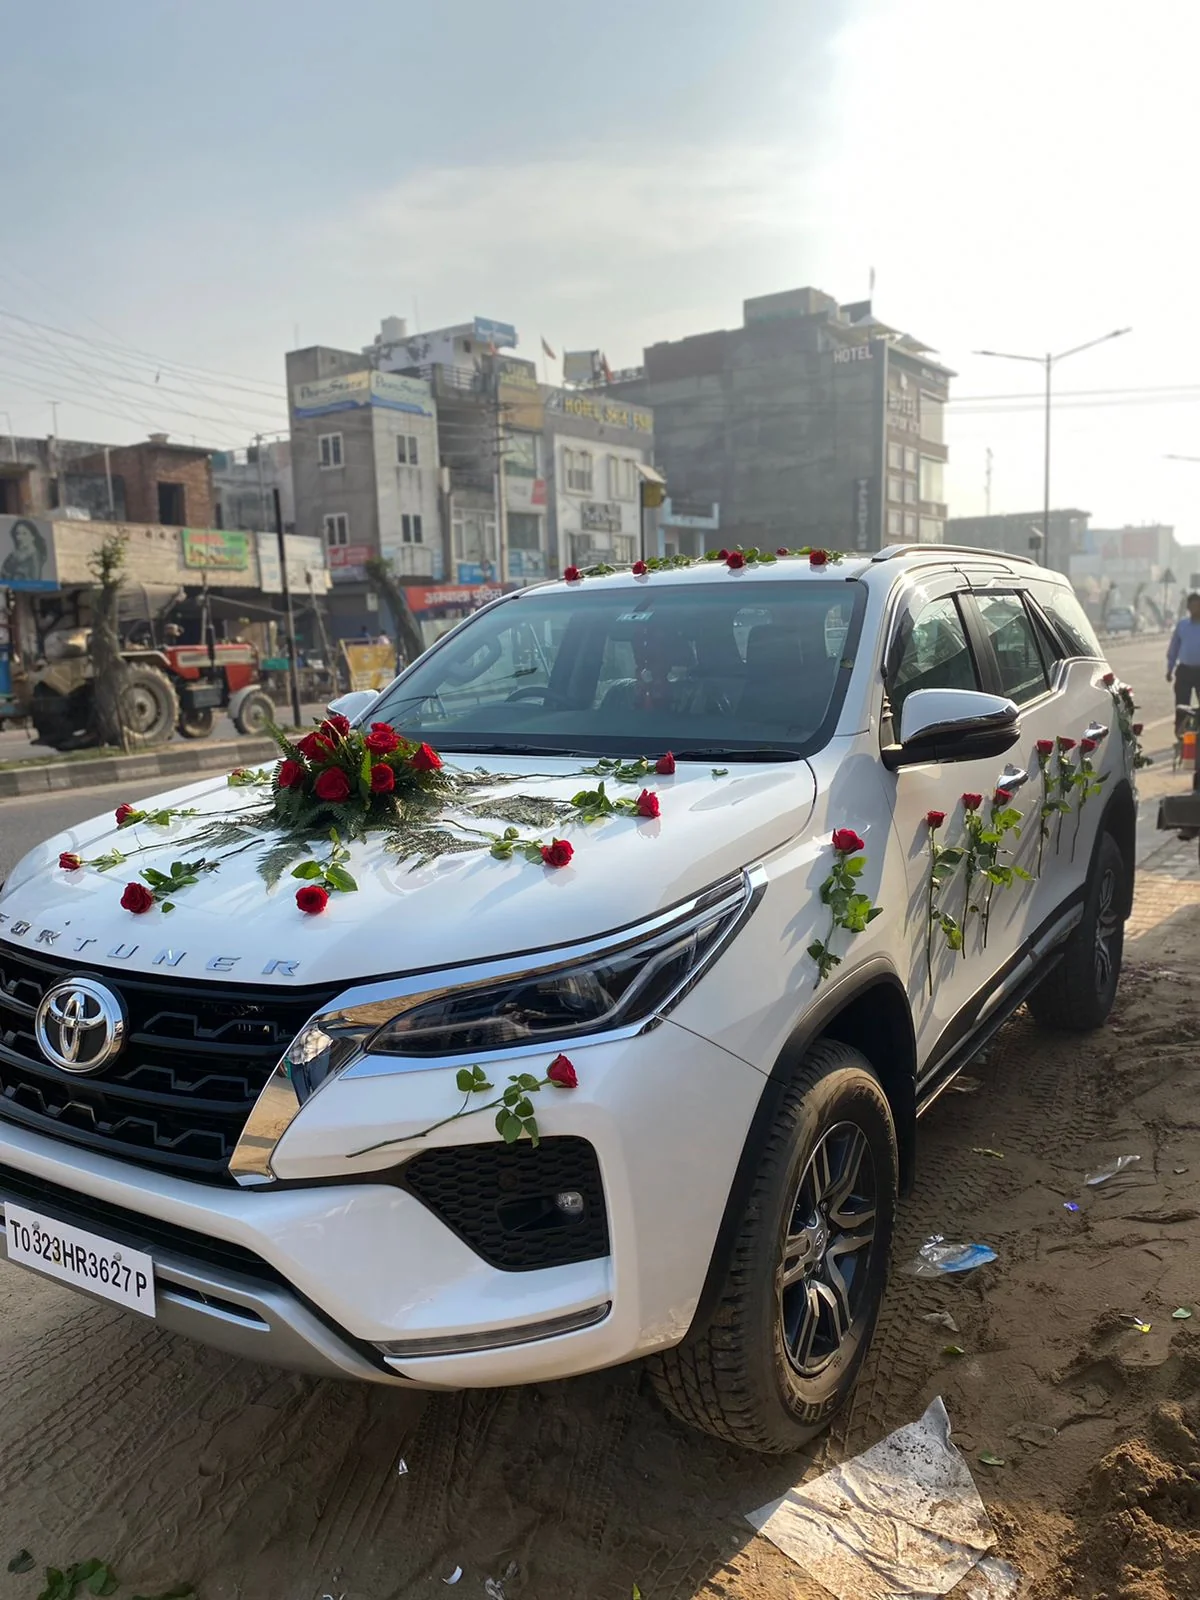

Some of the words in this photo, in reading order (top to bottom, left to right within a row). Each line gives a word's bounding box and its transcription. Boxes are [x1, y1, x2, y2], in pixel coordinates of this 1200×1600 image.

[833, 346, 874, 364] HOTEL
[472, 585, 502, 606] पुलिस
[0, 911, 302, 977] FORTUNER
